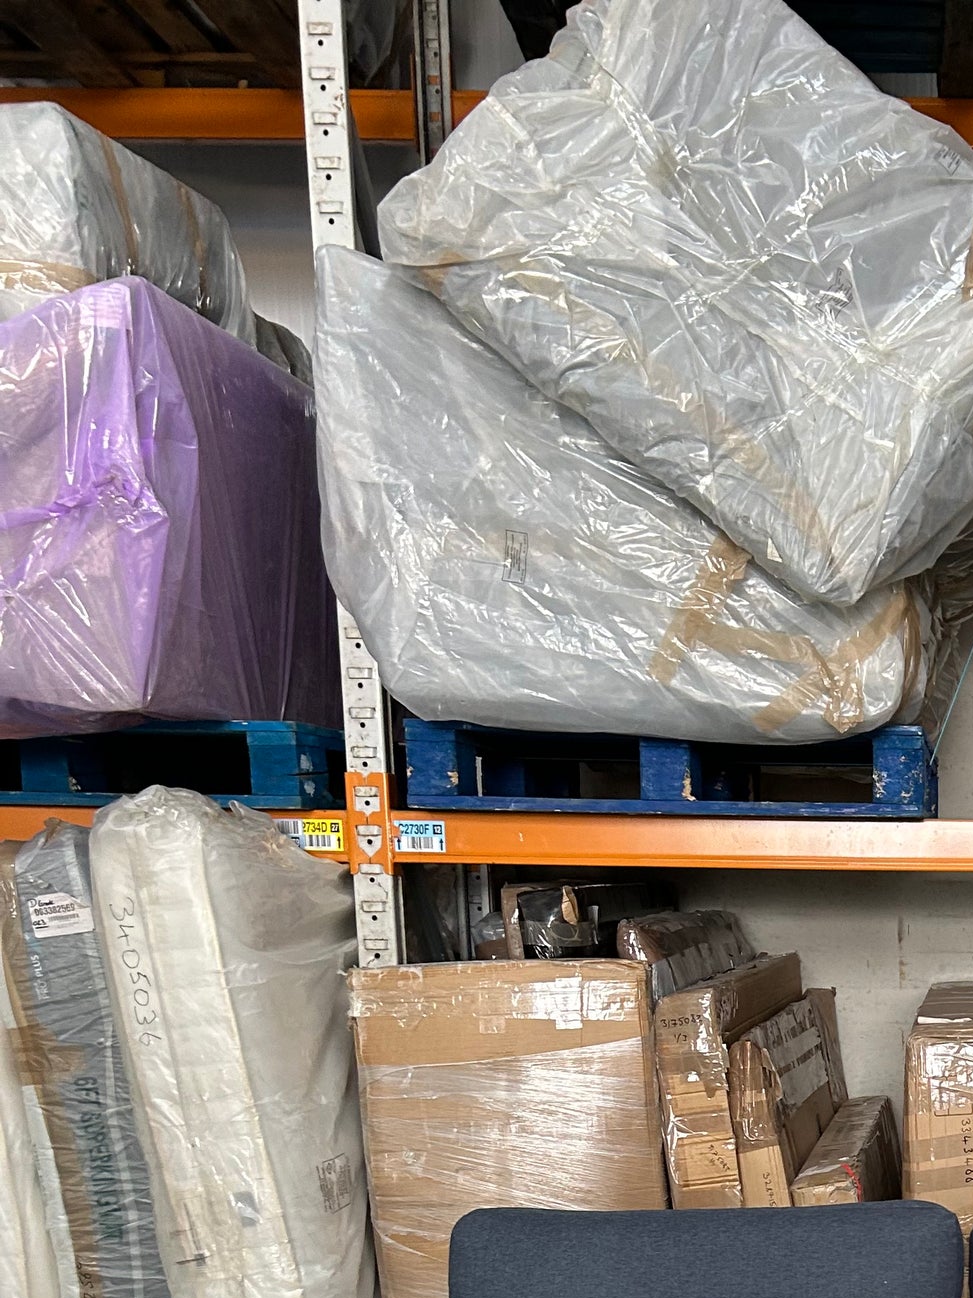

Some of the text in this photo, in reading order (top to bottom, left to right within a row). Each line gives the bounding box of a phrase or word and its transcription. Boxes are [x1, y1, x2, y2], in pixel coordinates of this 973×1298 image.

[398, 823, 430, 835] C2730F
[30, 954, 44, 978] PLUS
[109, 896, 162, 1047] 3405036
